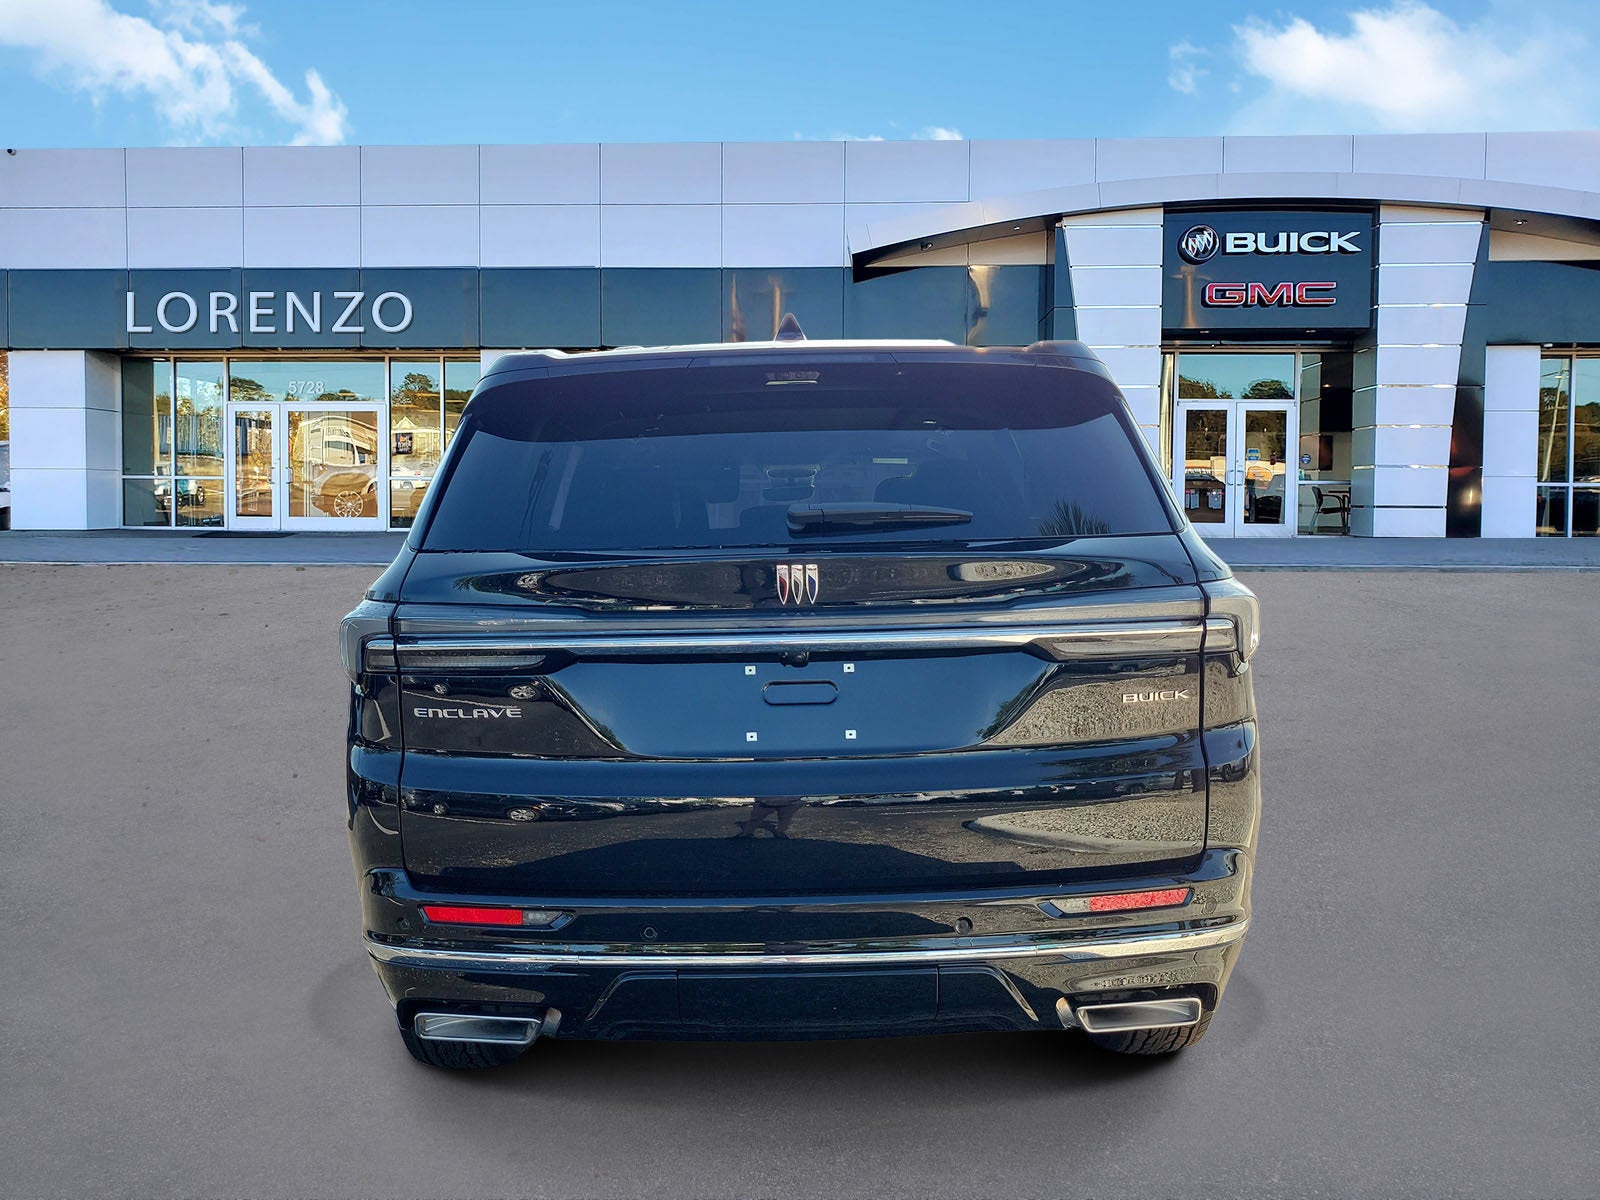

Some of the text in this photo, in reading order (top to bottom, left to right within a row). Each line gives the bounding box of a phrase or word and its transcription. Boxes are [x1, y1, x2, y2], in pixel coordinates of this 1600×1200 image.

[1225, 231, 1362, 253] BUICK
[1204, 282, 1337, 305] GMC
[126, 291, 413, 333] LORENZO
[288, 380, 325, 394] 5728
[1122, 689, 1190, 704] BUICK
[413, 707, 523, 719] ENCLAVE
